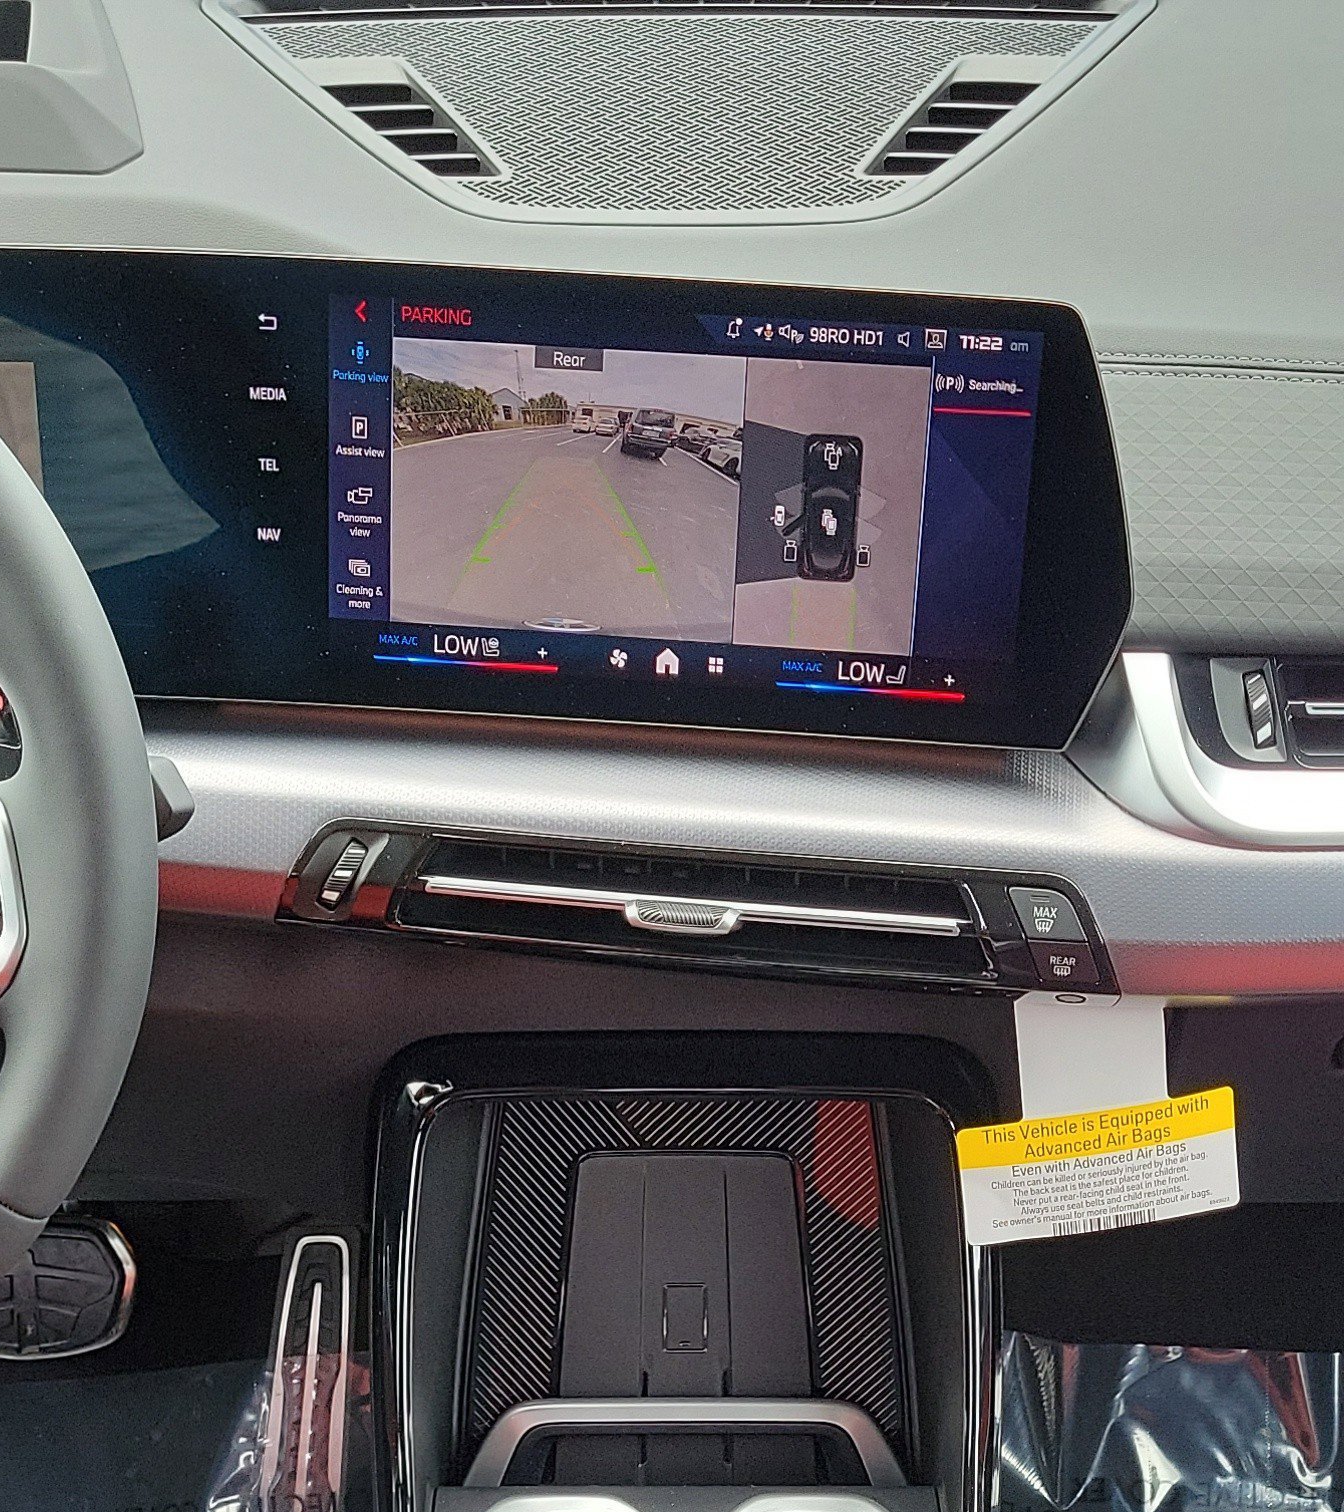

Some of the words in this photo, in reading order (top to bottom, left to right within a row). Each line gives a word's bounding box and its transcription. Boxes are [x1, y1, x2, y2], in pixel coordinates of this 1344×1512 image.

[401, 306, 472, 326] PARKING
[853, 329, 884, 346] HD1
[959, 334, 1004, 351] 11:22
[1010, 340, 1029, 352] am
[553, 351, 586, 367] Rear
[332, 369, 366, 383] Parking
[367, 372, 389, 383] view
[249, 386, 287, 401] MEDIA
[335, 444, 363, 457] Assist
[363, 447, 385, 459] view
[257, 458, 280, 472] TEL
[337, 511, 383, 525] Panorama
[256, 527, 281, 542] NAV
[349, 527, 371, 538] view
[336, 584, 374, 598] Cleaning
[375, 586, 383, 597] &
[348, 599, 371, 609] more
[378, 634, 400, 645] MAX
[433, 634, 479, 656] LOW
[782, 660, 803, 671] MAX
[838, 660, 885, 683] LOW
[1033, 906, 1058, 919] MAX
[1049, 955, 1076, 966] REAR
[981, 1127, 1016, 1144] This
[1019, 1120, 1078, 1140] Vehicle
[1081, 1117, 1095, 1132] is
[1099, 1102, 1173, 1130] Equipped
[1176, 1095, 1209, 1115] with
[1024, 1134, 1102, 1159] Advanced
[1106, 1131, 1130, 1148] Air
[1132, 1126, 1171, 1143] Bags
[1011, 1165, 1042, 1178] Even
[1044, 1160, 1070, 1174] with
[1072, 1150, 1133, 1171] Advanced
[1136, 1147, 1153, 1161] Air
[1156, 1142, 1187, 1160] Bags
[991, 1180, 1026, 1190] Children
[1026, 1178, 1042, 1187] can
[1042, 1176, 1053, 1185] be
[1054, 1173, 1076, 1183] killed
[1077, 1171, 1086, 1180] or
[1087, 1165, 1124, 1179] seriously
[1124, 1161, 1153, 1174] injured
[1154, 1160, 1164, 1171] by
[1165, 1157, 1178, 1166] the
[1179, 1155, 1189, 1163] air
[1190, 1152, 1209, 1161] bag.
[1013, 1188, 1029, 1198] The
[1030, 1186, 1050, 1196] back
[1050, 1184, 1069, 1193] seat
[1069, 1183, 1077, 1191] is
[1078, 1181, 1092, 1190] the
[1092, 1175, 1120, 1188] safest
[1119, 1173, 1140, 1186] place
[1141, 1170, 1153, 1181] for
[1154, 1165, 1189, 1178] children.
[1013, 1198, 1037, 1208] Never
[1038, 1196, 1052, 1206] put
[1060, 1189, 1104, 1202] rear-facing
[1105, 1185, 1125, 1196] child
[1126, 1183, 1144, 1192] seat
[1145, 1180, 1153, 1189] in
[1153, 1178, 1167, 1188] the
[1168, 1173, 1190, 1185] front.
[1020, 1206, 1049, 1216] Always
[1050, 1204, 1065, 1213] use
[1066, 1201, 1084, 1211] seat
[1085, 1198, 1105, 1208] belts
[1106, 1195, 1122, 1205] and
[1123, 1192, 1143, 1203] child
[1143, 1185, 1183, 1199] restraints.
[992, 1219, 1009, 1229] See
[1009, 1216, 1042, 1227] owner's
[1042, 1212, 1073, 1223] manual
[1073, 1210, 1085, 1220] for
[1086, 1208, 1108, 1217] more
[1108, 1200, 1155, 1214] information
[1155, 1196, 1179, 1206] about
[1179, 1192, 1191, 1201] air
